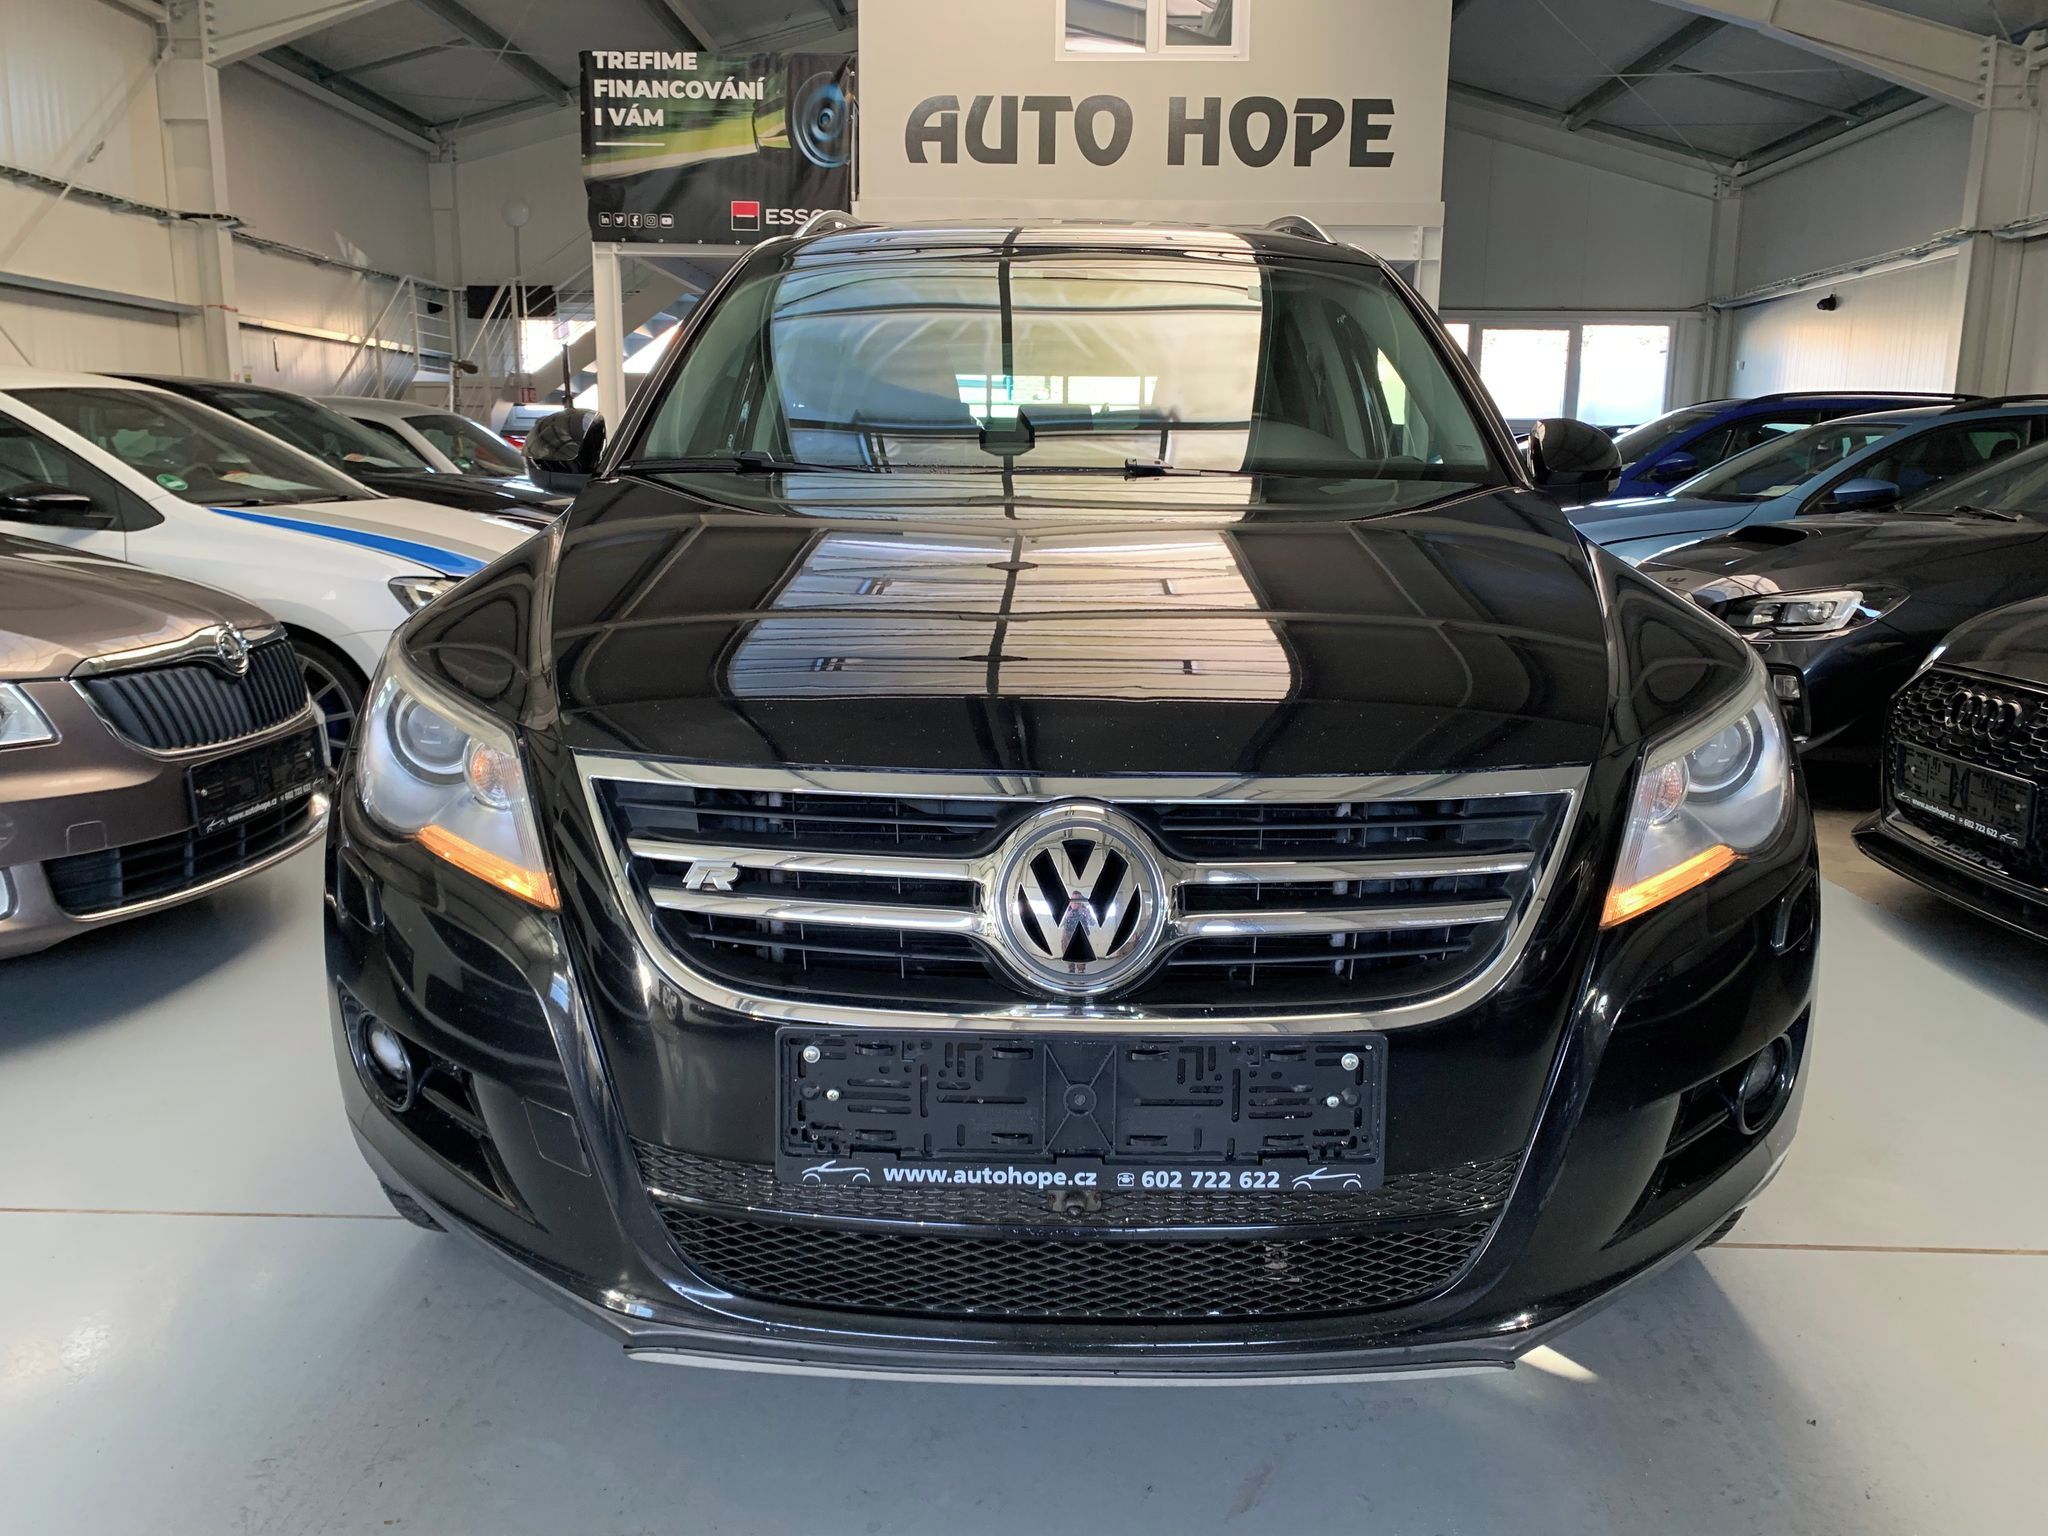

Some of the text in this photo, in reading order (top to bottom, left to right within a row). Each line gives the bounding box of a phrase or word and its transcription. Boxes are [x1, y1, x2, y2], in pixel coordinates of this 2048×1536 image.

[593, 76, 766, 101] FINANCOVÁNÍ
[594, 103, 665, 127] I VÁM
[904, 95, 1396, 168] AUTO HOPE
[883, 1166, 1280, 1190] www.autohope.cz 602 722 622
